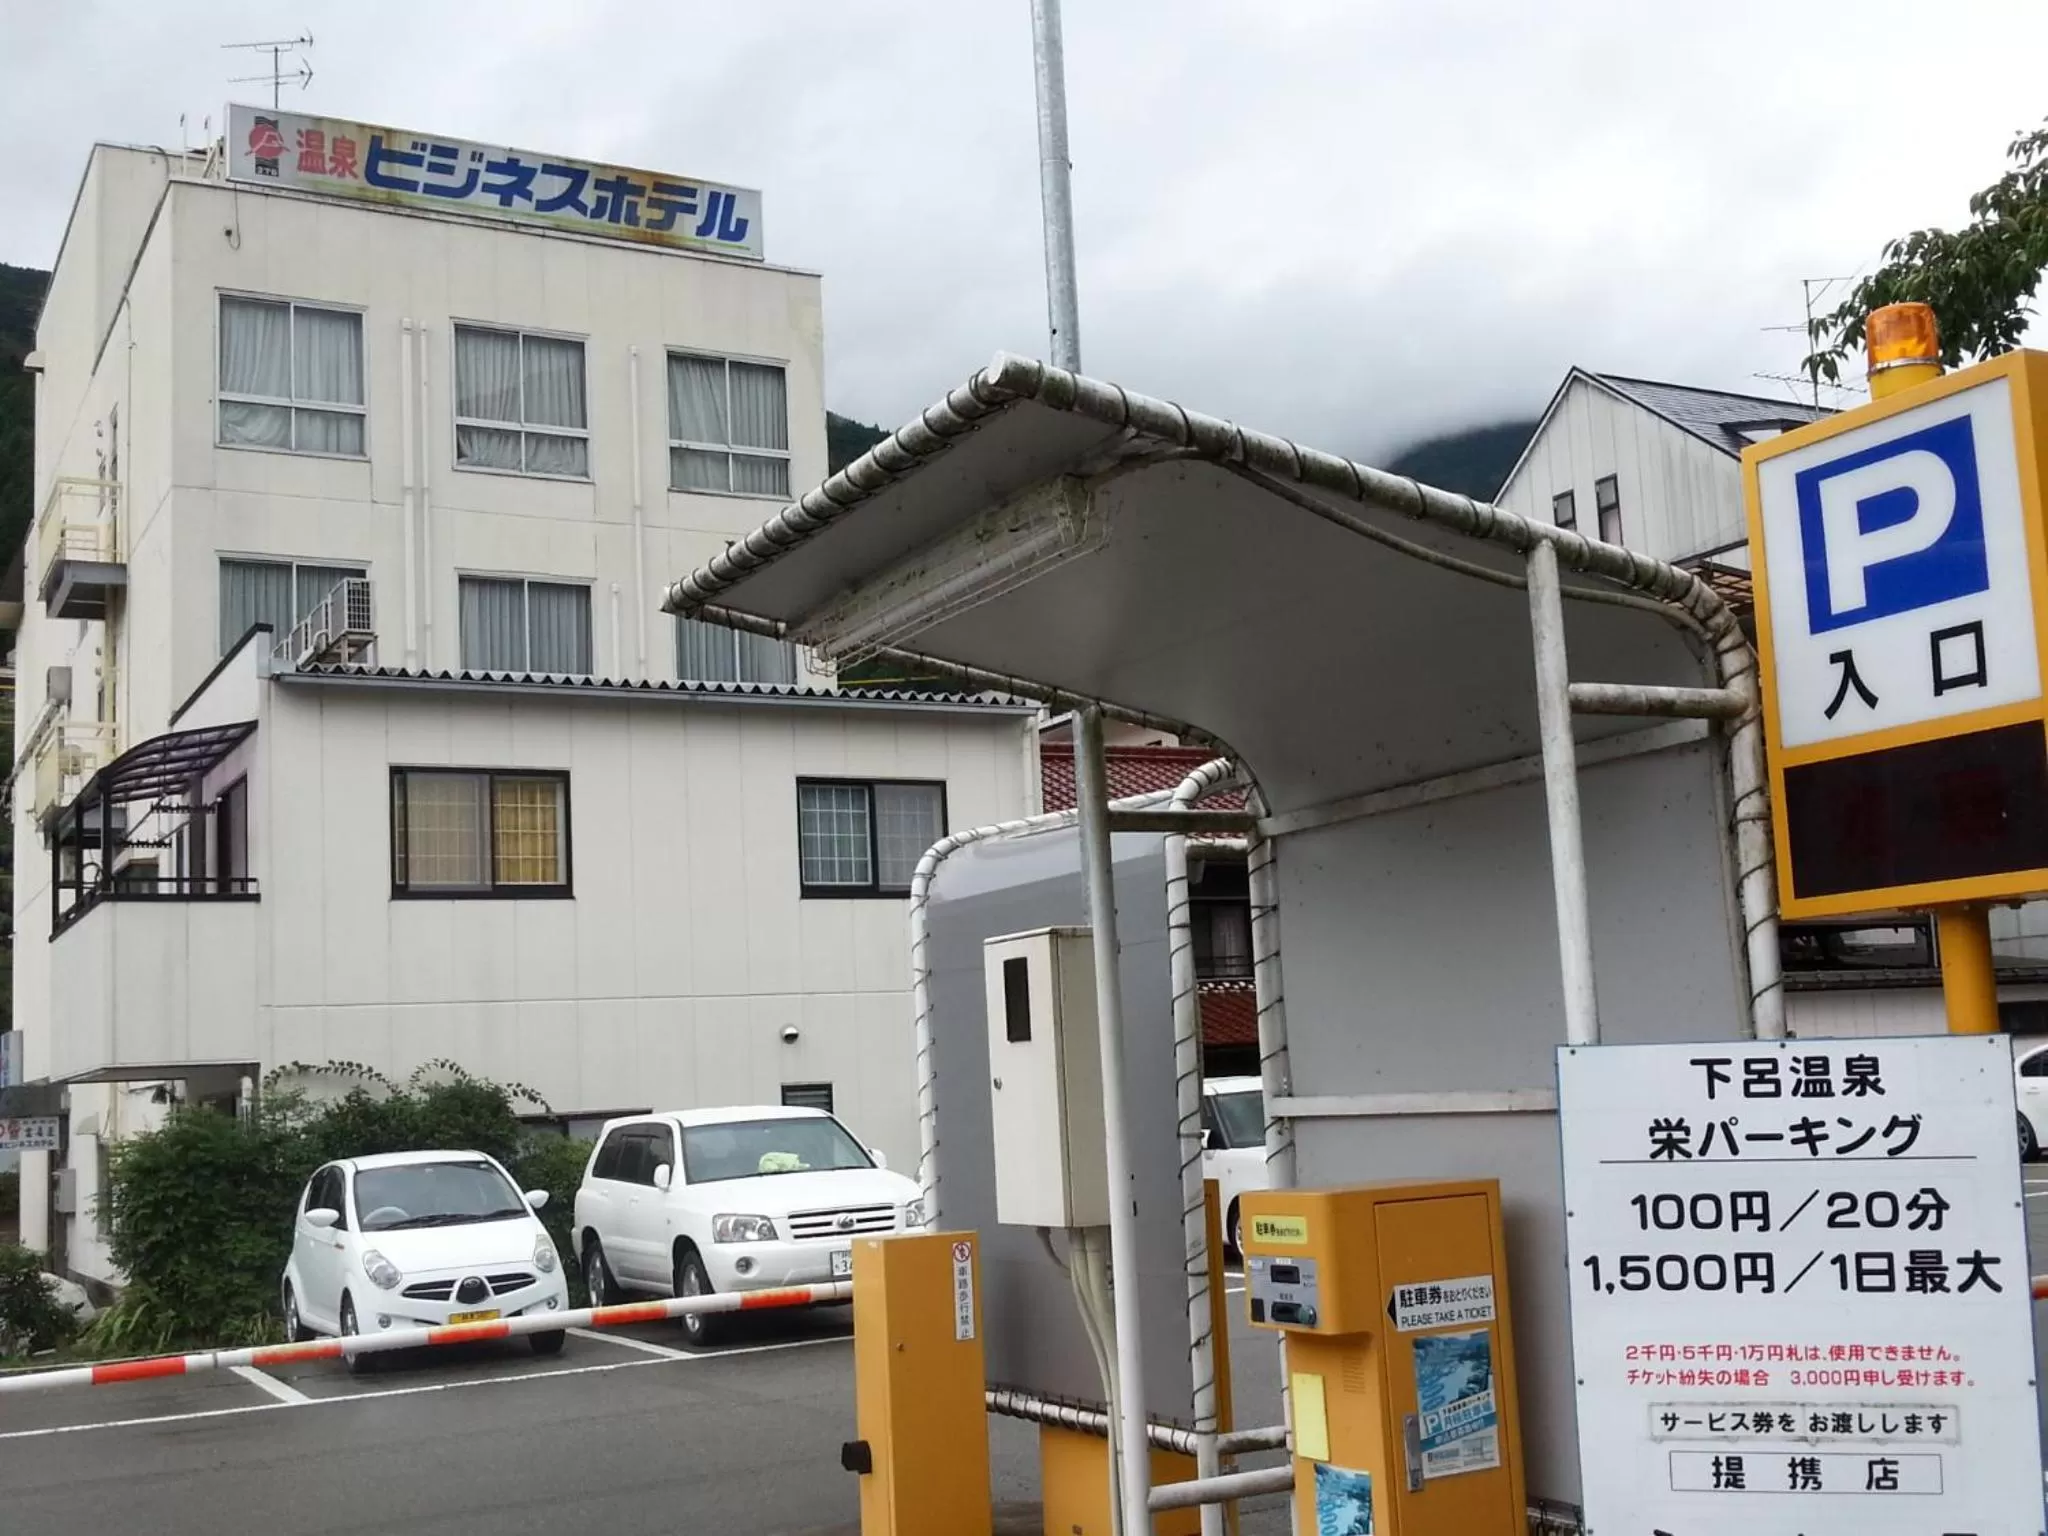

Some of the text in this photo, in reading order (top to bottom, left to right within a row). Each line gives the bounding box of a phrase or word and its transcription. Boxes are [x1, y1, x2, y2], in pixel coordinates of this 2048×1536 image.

[296, 128, 750, 243] 温泉 ビジネスホテル
[1818, 449, 1957, 616] P
[1823, 619, 1988, 722] 入口
[1689, 1054, 1887, 1101] 下呂温泉
[1648, 1112, 1924, 1162] 栄パーキング
[1401, 1306, 1492, 1327] PLEASE TAKE A TICKET
[1627, 1369, 1770, 1387] チケット紛失の場合
[1660, 1412, 1948, 1434] サービス券を お渡しします
[1711, 1455, 1899, 1491] 提携店
